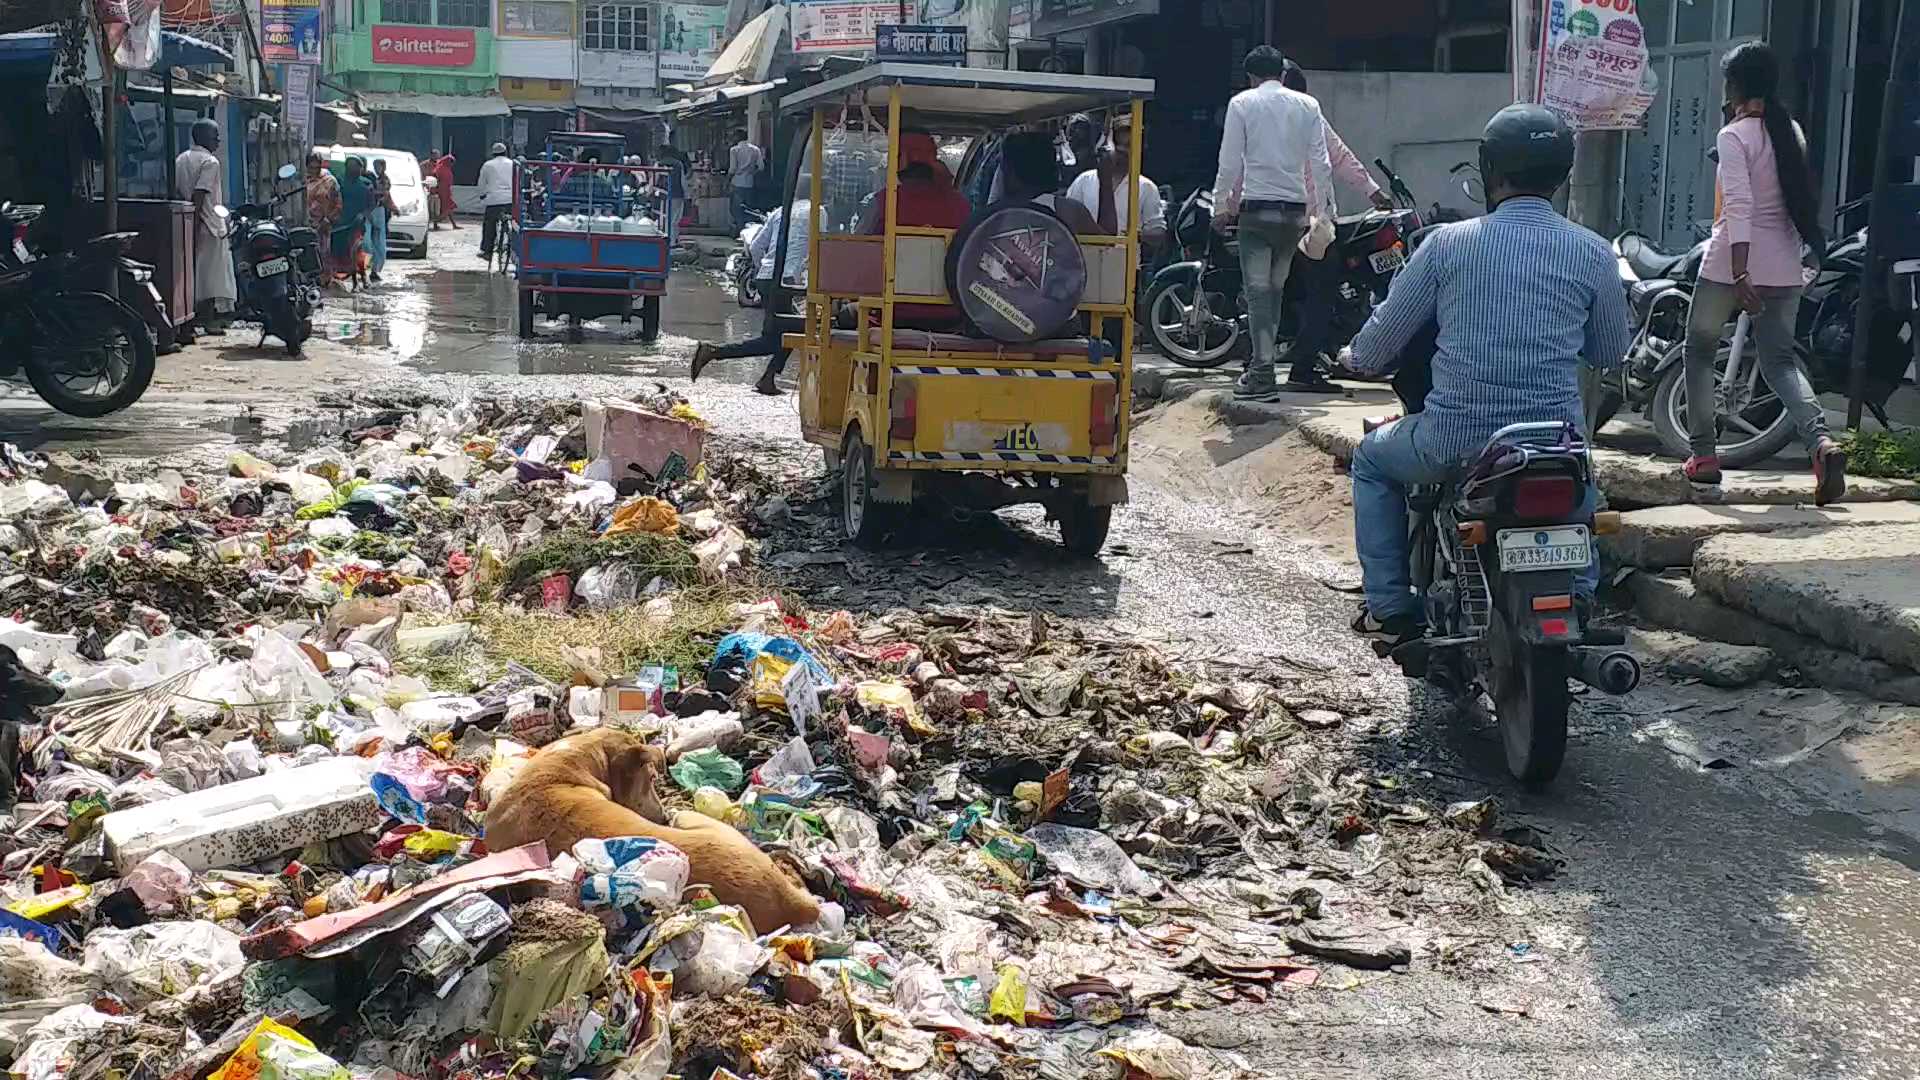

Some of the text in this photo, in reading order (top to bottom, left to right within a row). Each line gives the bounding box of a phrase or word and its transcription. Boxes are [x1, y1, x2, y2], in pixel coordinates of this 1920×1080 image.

[394, 38, 434, 53] airtel
[1585, 48, 1640, 72] अमूल
[1650, 144, 1661, 197] MAXX
